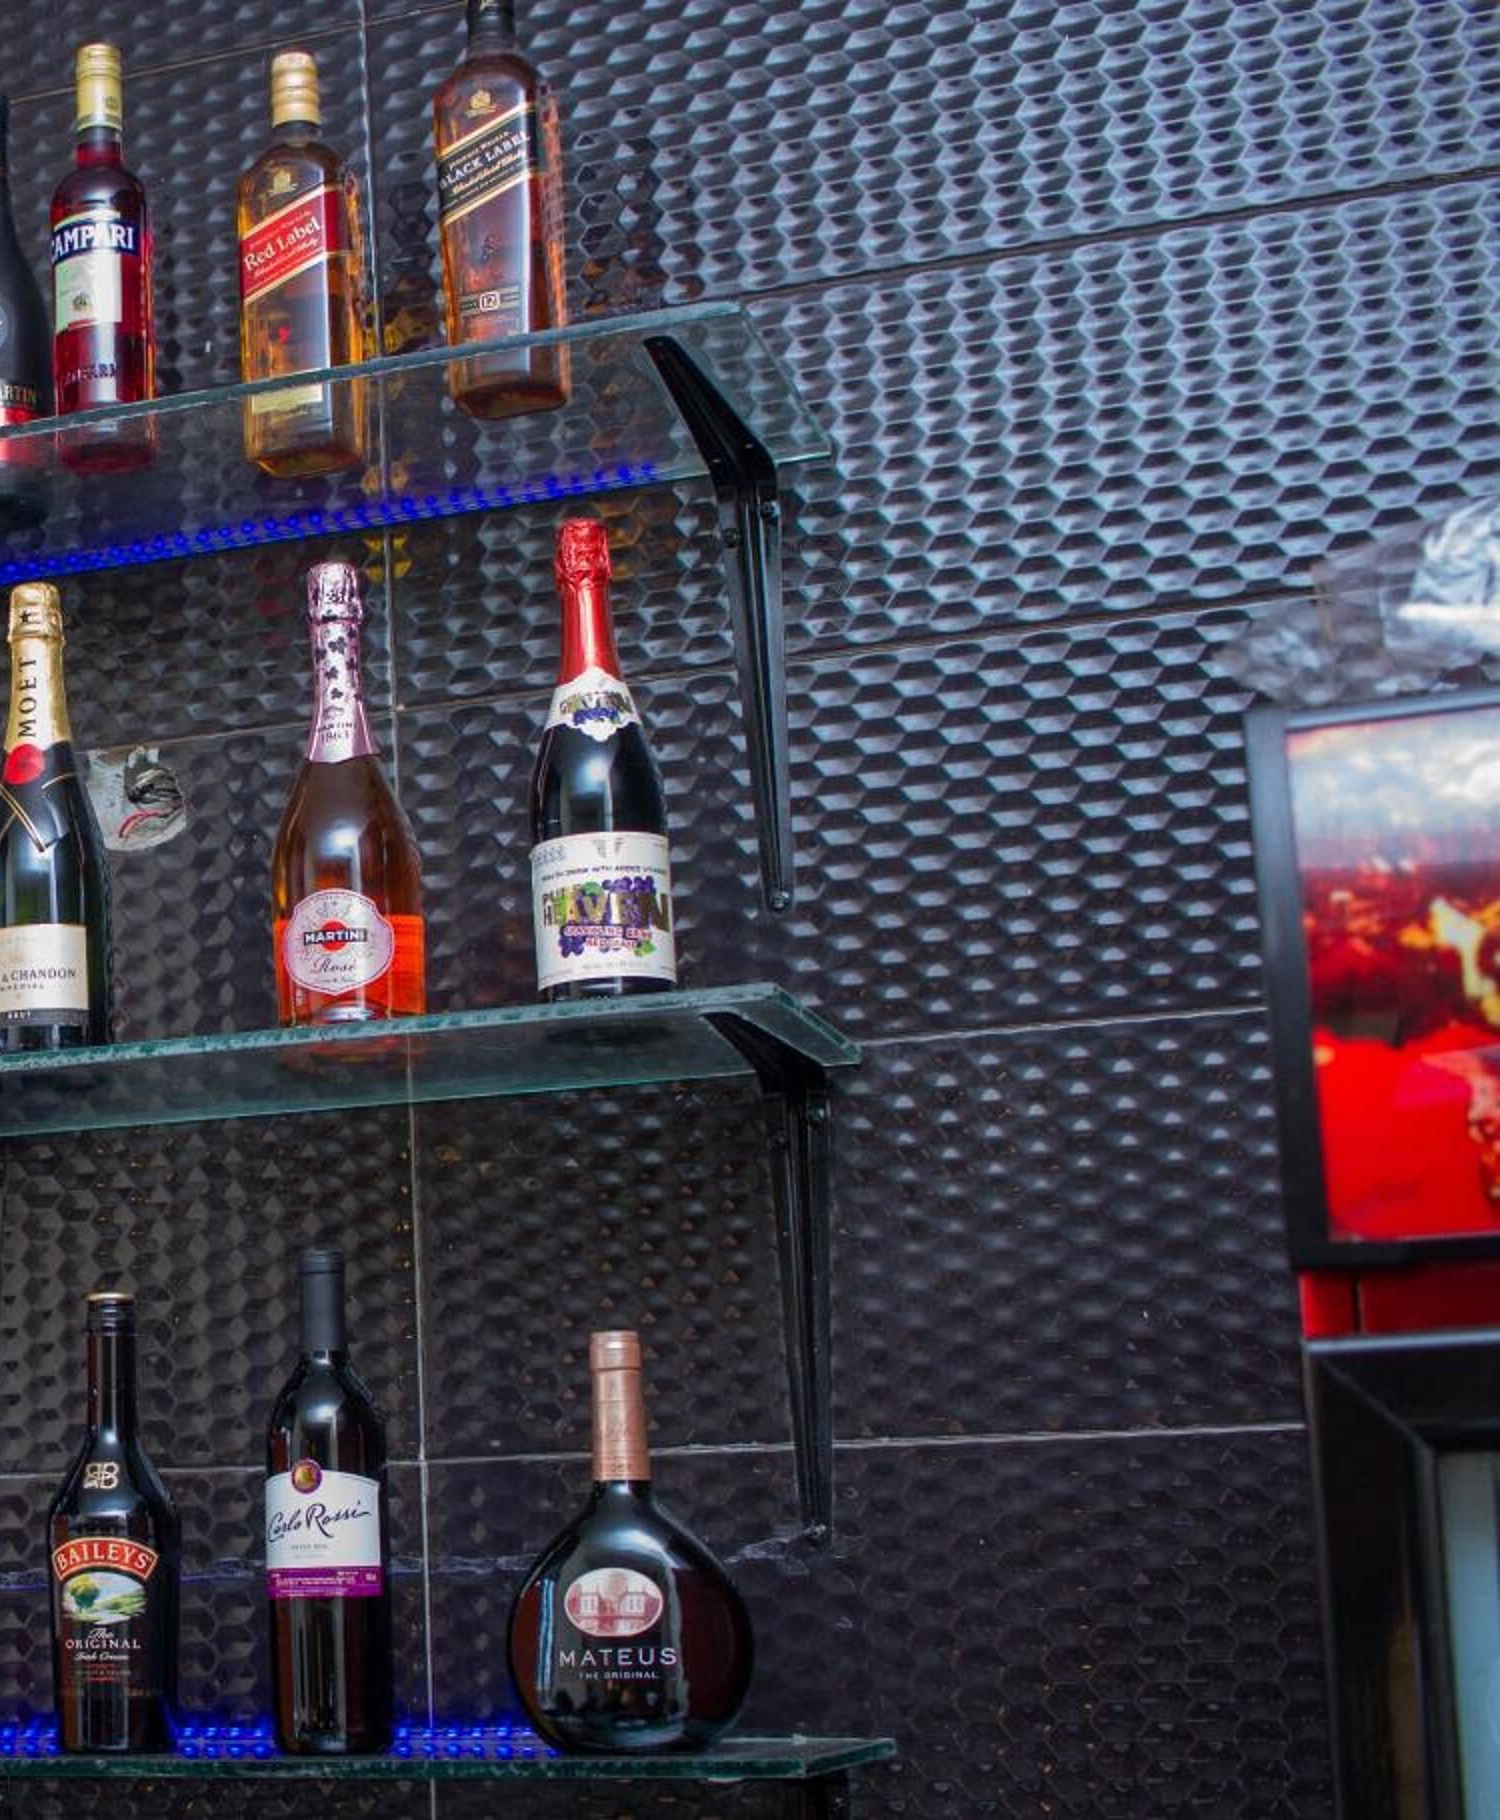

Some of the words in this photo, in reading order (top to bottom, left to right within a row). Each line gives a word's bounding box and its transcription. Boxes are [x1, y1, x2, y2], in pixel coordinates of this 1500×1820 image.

[485, 131, 531, 161] LABEL
[244, 241, 276, 271] Red
[276, 215, 321, 250] Label
[304, 929, 366, 943] MARTINI
[10, 967, 77, 981] CHANDON
[268, 1508, 303, 1543] Carlo
[304, 1500, 372, 1539] Rossi
[56, 1542, 150, 1573] BAILEYS
[65, 1639, 141, 1649] ORIGINAL
[558, 1647, 677, 1667] MATEUS
[579, 1672, 599, 1680] THE
